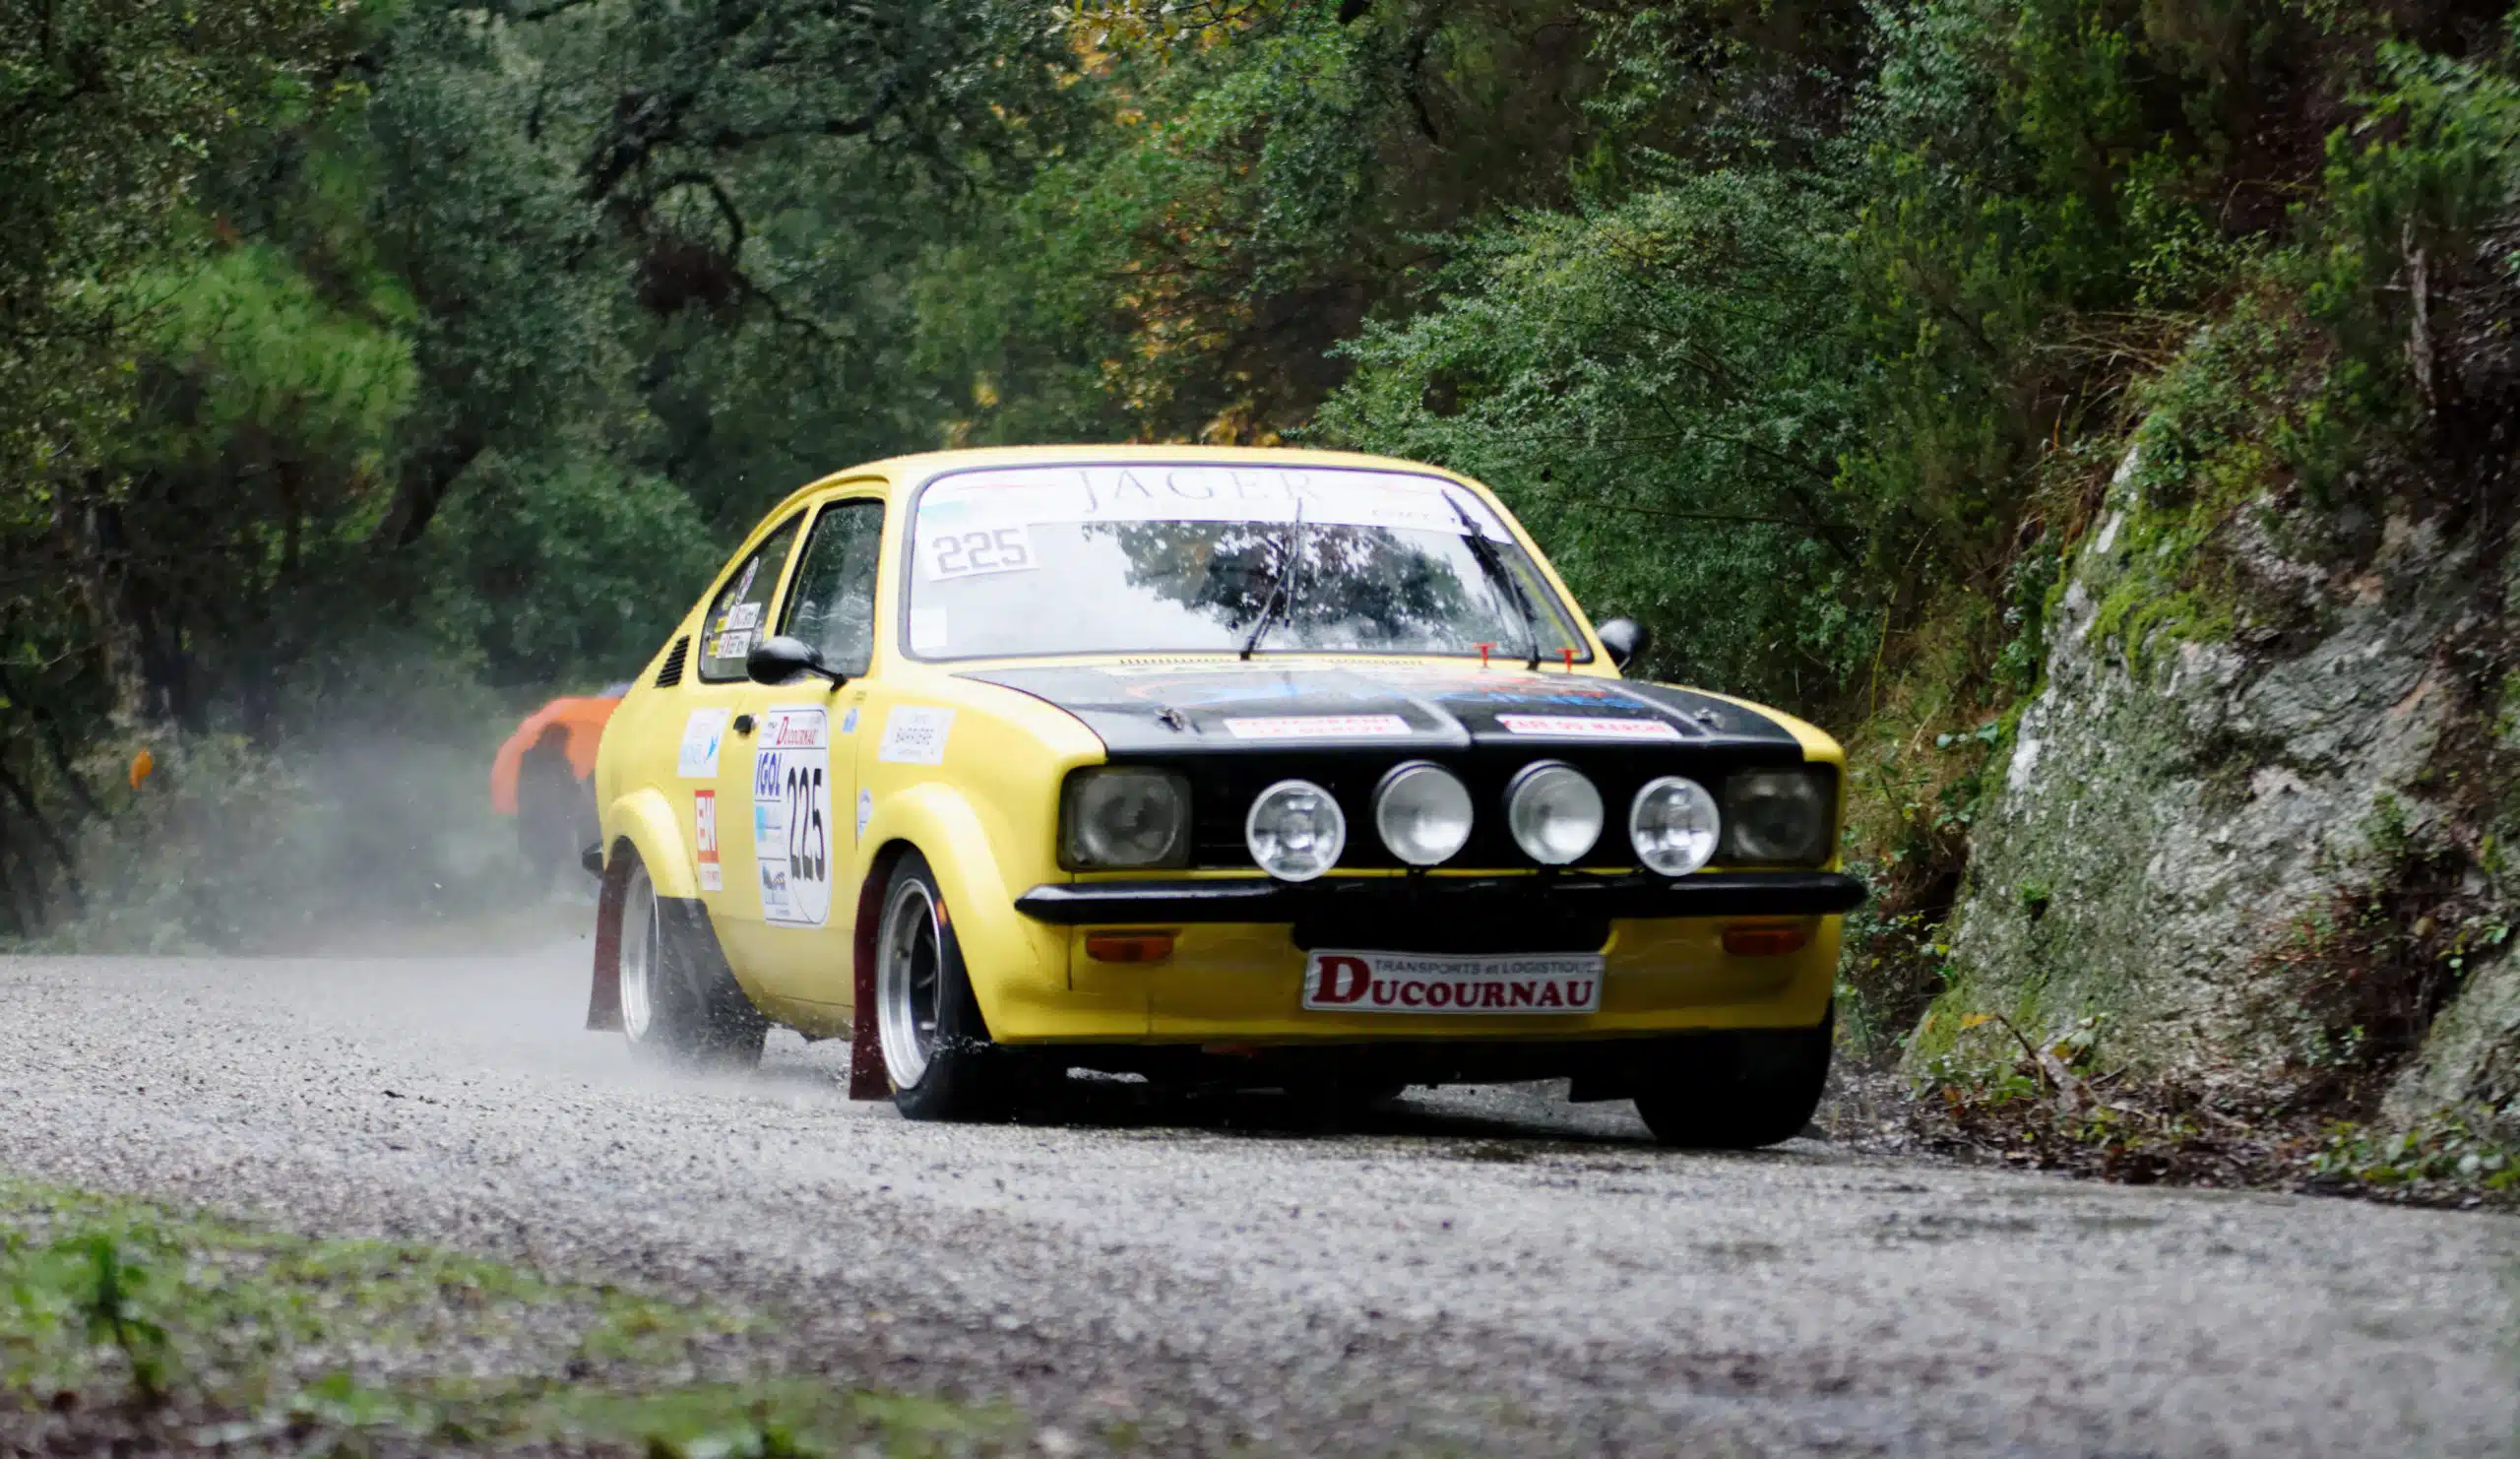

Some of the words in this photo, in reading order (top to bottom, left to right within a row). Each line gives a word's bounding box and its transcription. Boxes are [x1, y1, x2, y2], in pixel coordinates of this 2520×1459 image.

[932, 528, 1029, 574] 225
[755, 751, 783, 796] IGOL
[787, 766, 825, 883] 225
[1311, 956, 1595, 1008] DUCOURNAU
[1375, 959, 1480, 976] TRANSPORTS
